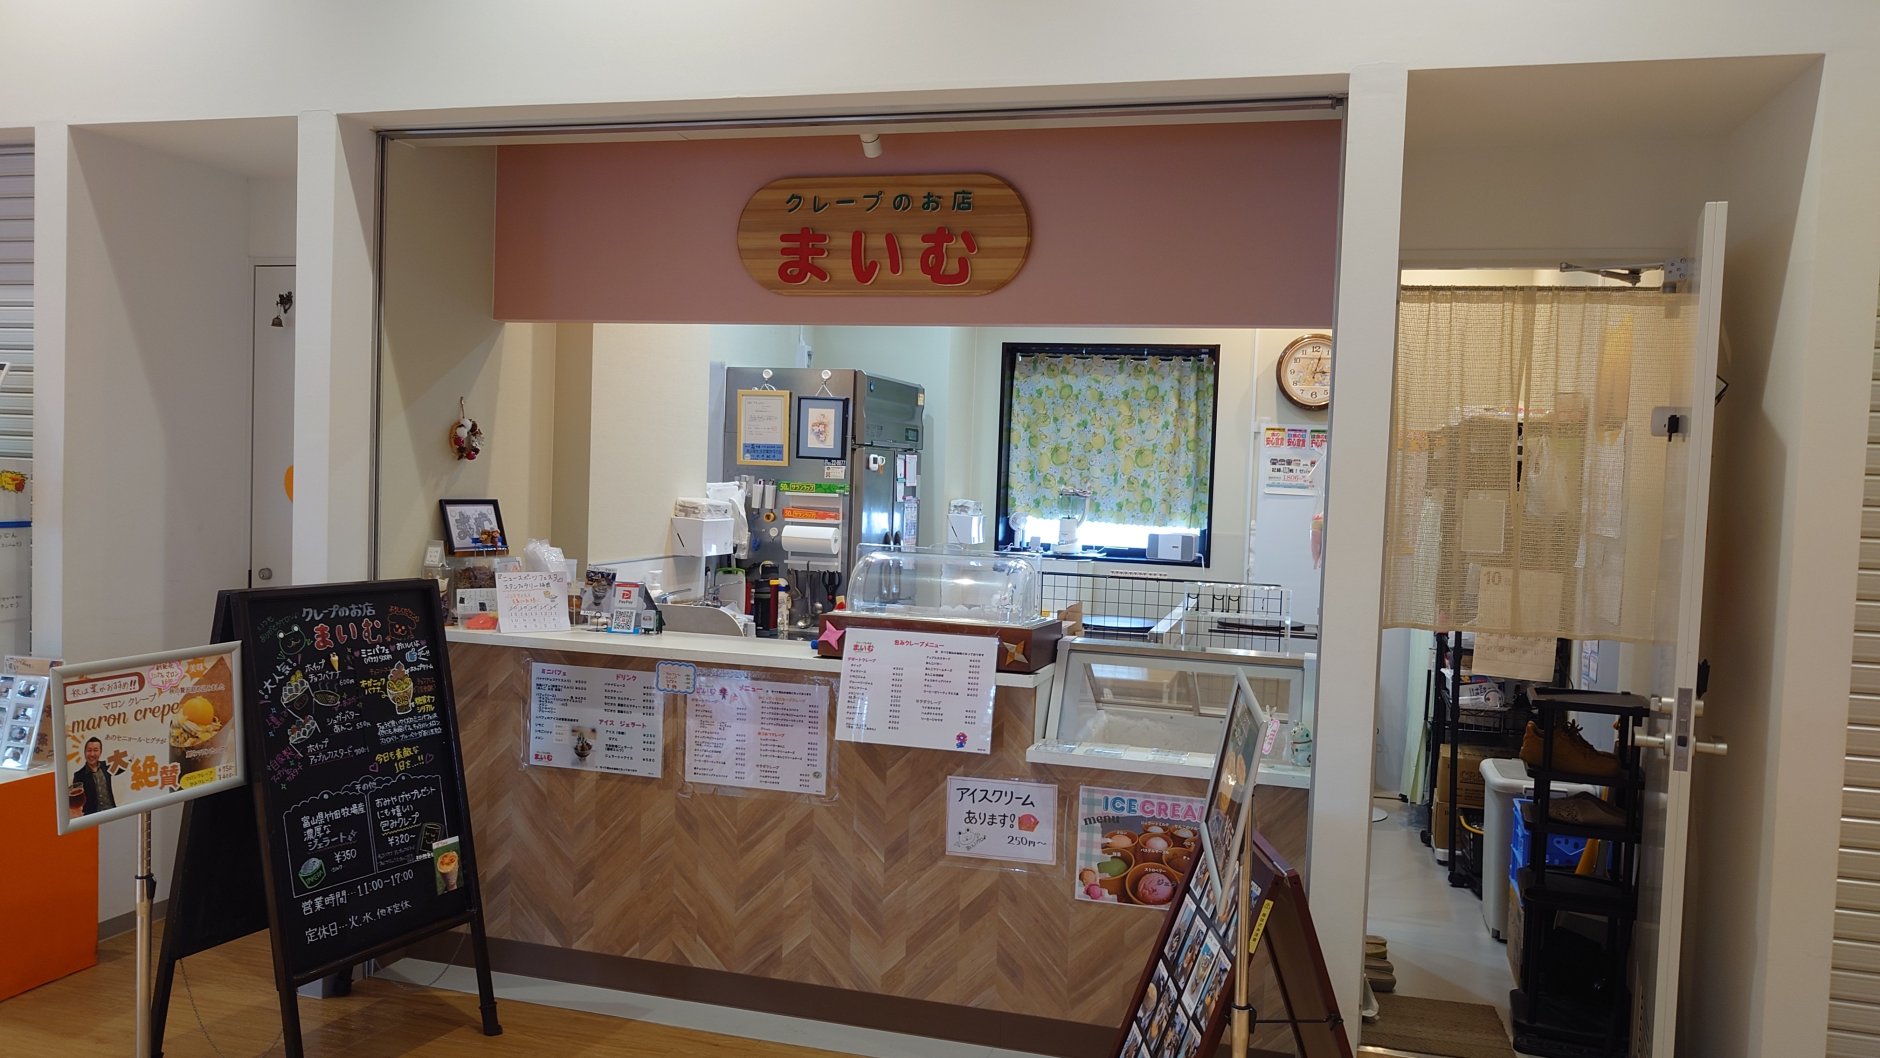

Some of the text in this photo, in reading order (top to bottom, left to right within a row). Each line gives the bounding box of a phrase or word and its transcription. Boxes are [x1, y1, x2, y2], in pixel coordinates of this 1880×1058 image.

[786, 190, 974, 213] クレープのお店
[778, 226, 978, 286] まいむ
[302, 602, 376, 622] クレープのお店
[314, 618, 382, 650] まいむ
[361, 645, 390, 657] ミニパフェ
[852, 639, 944, 652] まいむ 包みクレープメニュー
[305, 660, 325, 673] ホイップ
[541, 668, 637, 682] ミニパフェ ドリンク
[308, 670, 341, 683] チョコバナナ
[103, 692, 157, 711] マロン クレープ
[71, 711, 128, 734] maron
[134, 702, 181, 724] crepe
[326, 711, 360, 726] シュガーバター
[598, 719, 647, 729] アイス ジェラート
[306, 738, 328, 754] ホイップ
[308, 745, 352, 766] アップルカスタード
[376, 746, 420, 764] 今日も素敵な
[107, 749, 181, 792] 大絶賛
[956, 788, 1036, 808] アイスクリーム
[1101, 796, 1137, 815] ICE
[301, 802, 367, 828] 富山県竹田牧場産
[377, 805, 414, 820] にも嬉しい
[964, 810, 1016, 829] あります!
[1082, 814, 1120, 826] menu
[379, 812, 420, 832] 包みクレープ
[303, 825, 332, 842] 濃厚な
[307, 833, 348, 850] ジェラート
[333, 849, 358, 863] ¥350
[1144, 868, 1168, 876] ストロベリー
